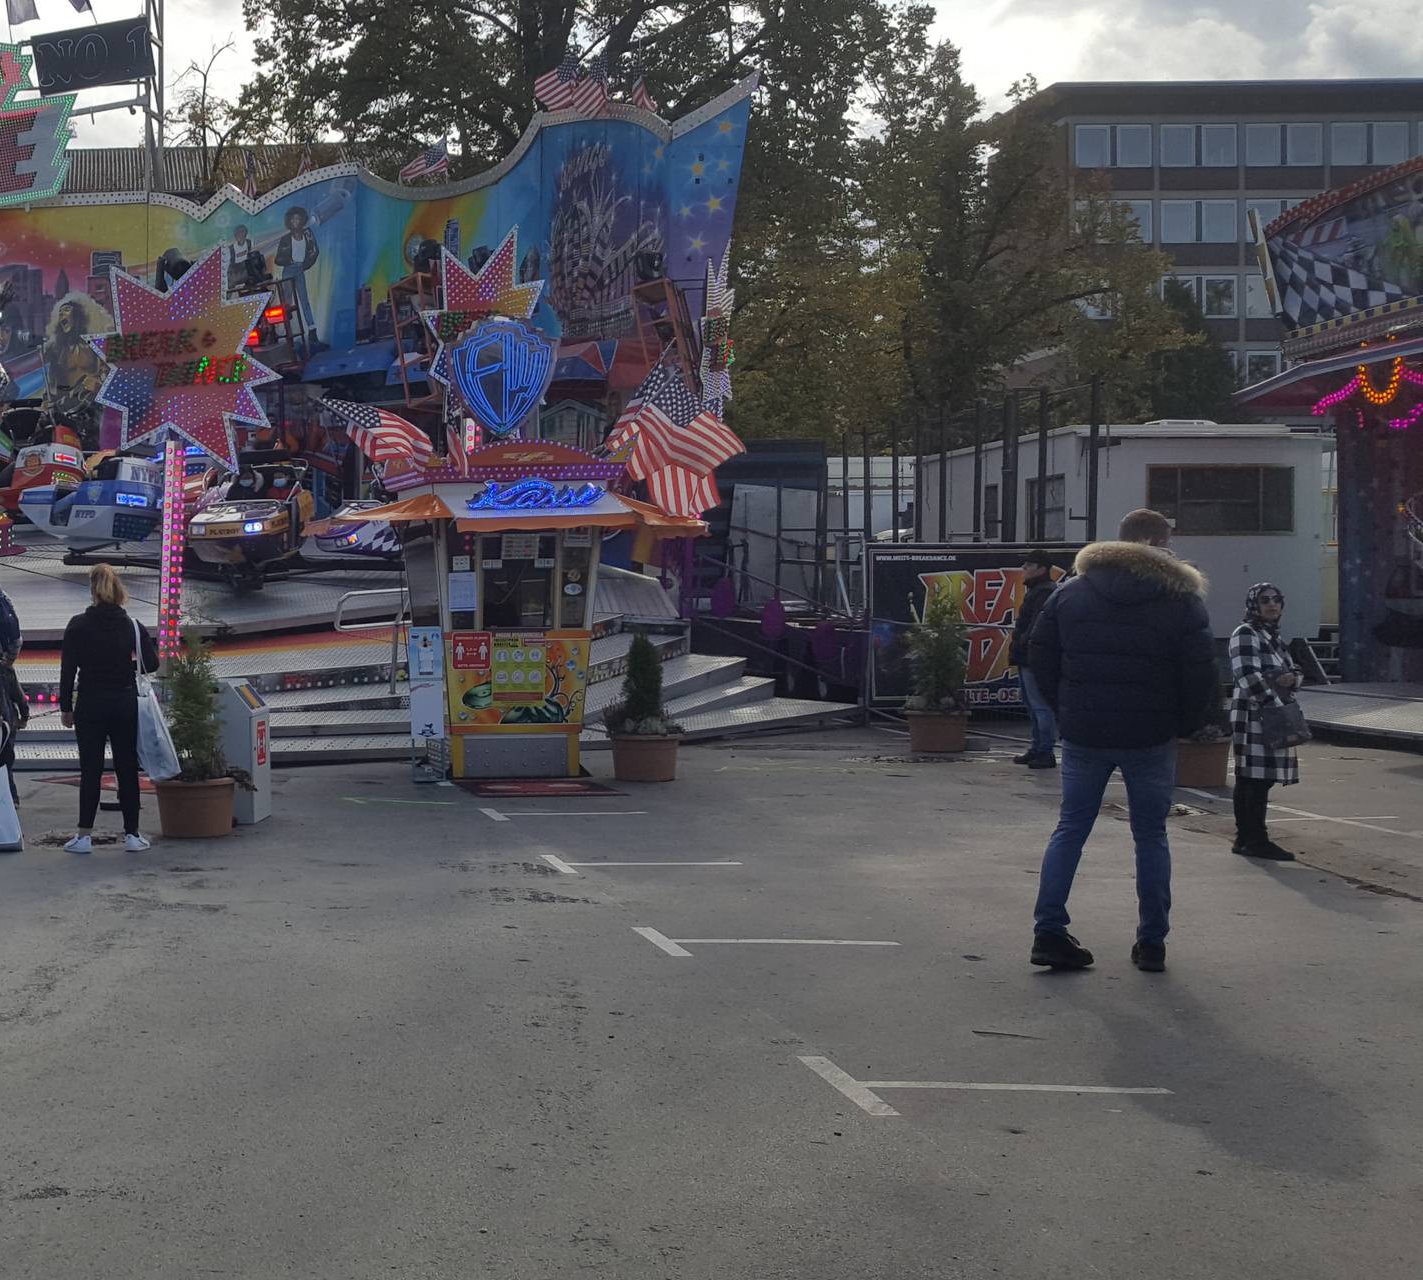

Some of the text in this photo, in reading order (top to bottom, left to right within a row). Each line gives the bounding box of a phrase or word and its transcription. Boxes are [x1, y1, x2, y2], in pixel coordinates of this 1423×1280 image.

[36, 25, 149, 88] NO 1
[74, 510, 96, 519] NYPD
